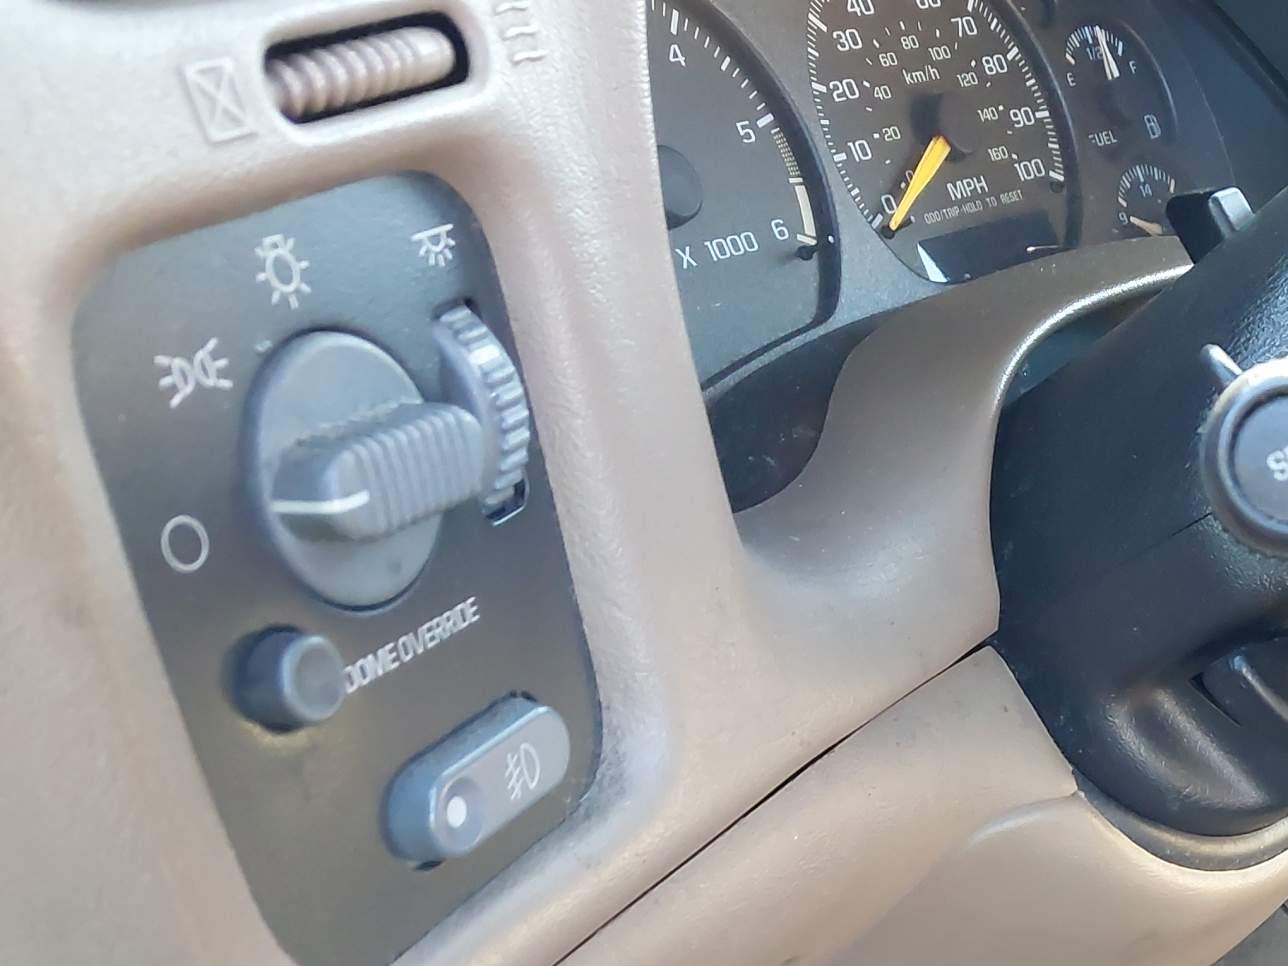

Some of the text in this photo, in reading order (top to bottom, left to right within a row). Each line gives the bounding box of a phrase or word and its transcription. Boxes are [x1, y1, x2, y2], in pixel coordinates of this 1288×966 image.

[950, 16, 978, 38] 70
[832, 29, 863, 51] 30
[900, 35, 919, 50] 80
[668, 44, 686, 67] 4
[879, 52, 898, 67] 60
[928, 45, 951, 61] 100
[902, 65, 940, 85] km/h
[981, 54, 1008, 75] 80
[1128, 60, 1138, 74] F
[956, 72, 979, 87] 120
[1066, 72, 1077, 87] E
[829, 79, 860, 102] 20
[873, 85, 892, 100] 40
[977, 107, 998, 123] 140
[1009, 107, 1036, 128] 90
[736, 121, 756, 143] 5
[882, 126, 901, 142] 20
[847, 140, 873, 162] 10
[987, 146, 1009, 161] 160
[1013, 158, 1046, 182] 100
[946, 175, 989, 201] MPH
[1139, 183, 1153, 198] 14
[881, 194, 898, 215] 0
[1118, 211, 1129, 225] 9
[771, 219, 790, 240] 6
[675, 231, 759, 269] X 1000
[343, 596, 481, 694] DOME OVERRIDE
